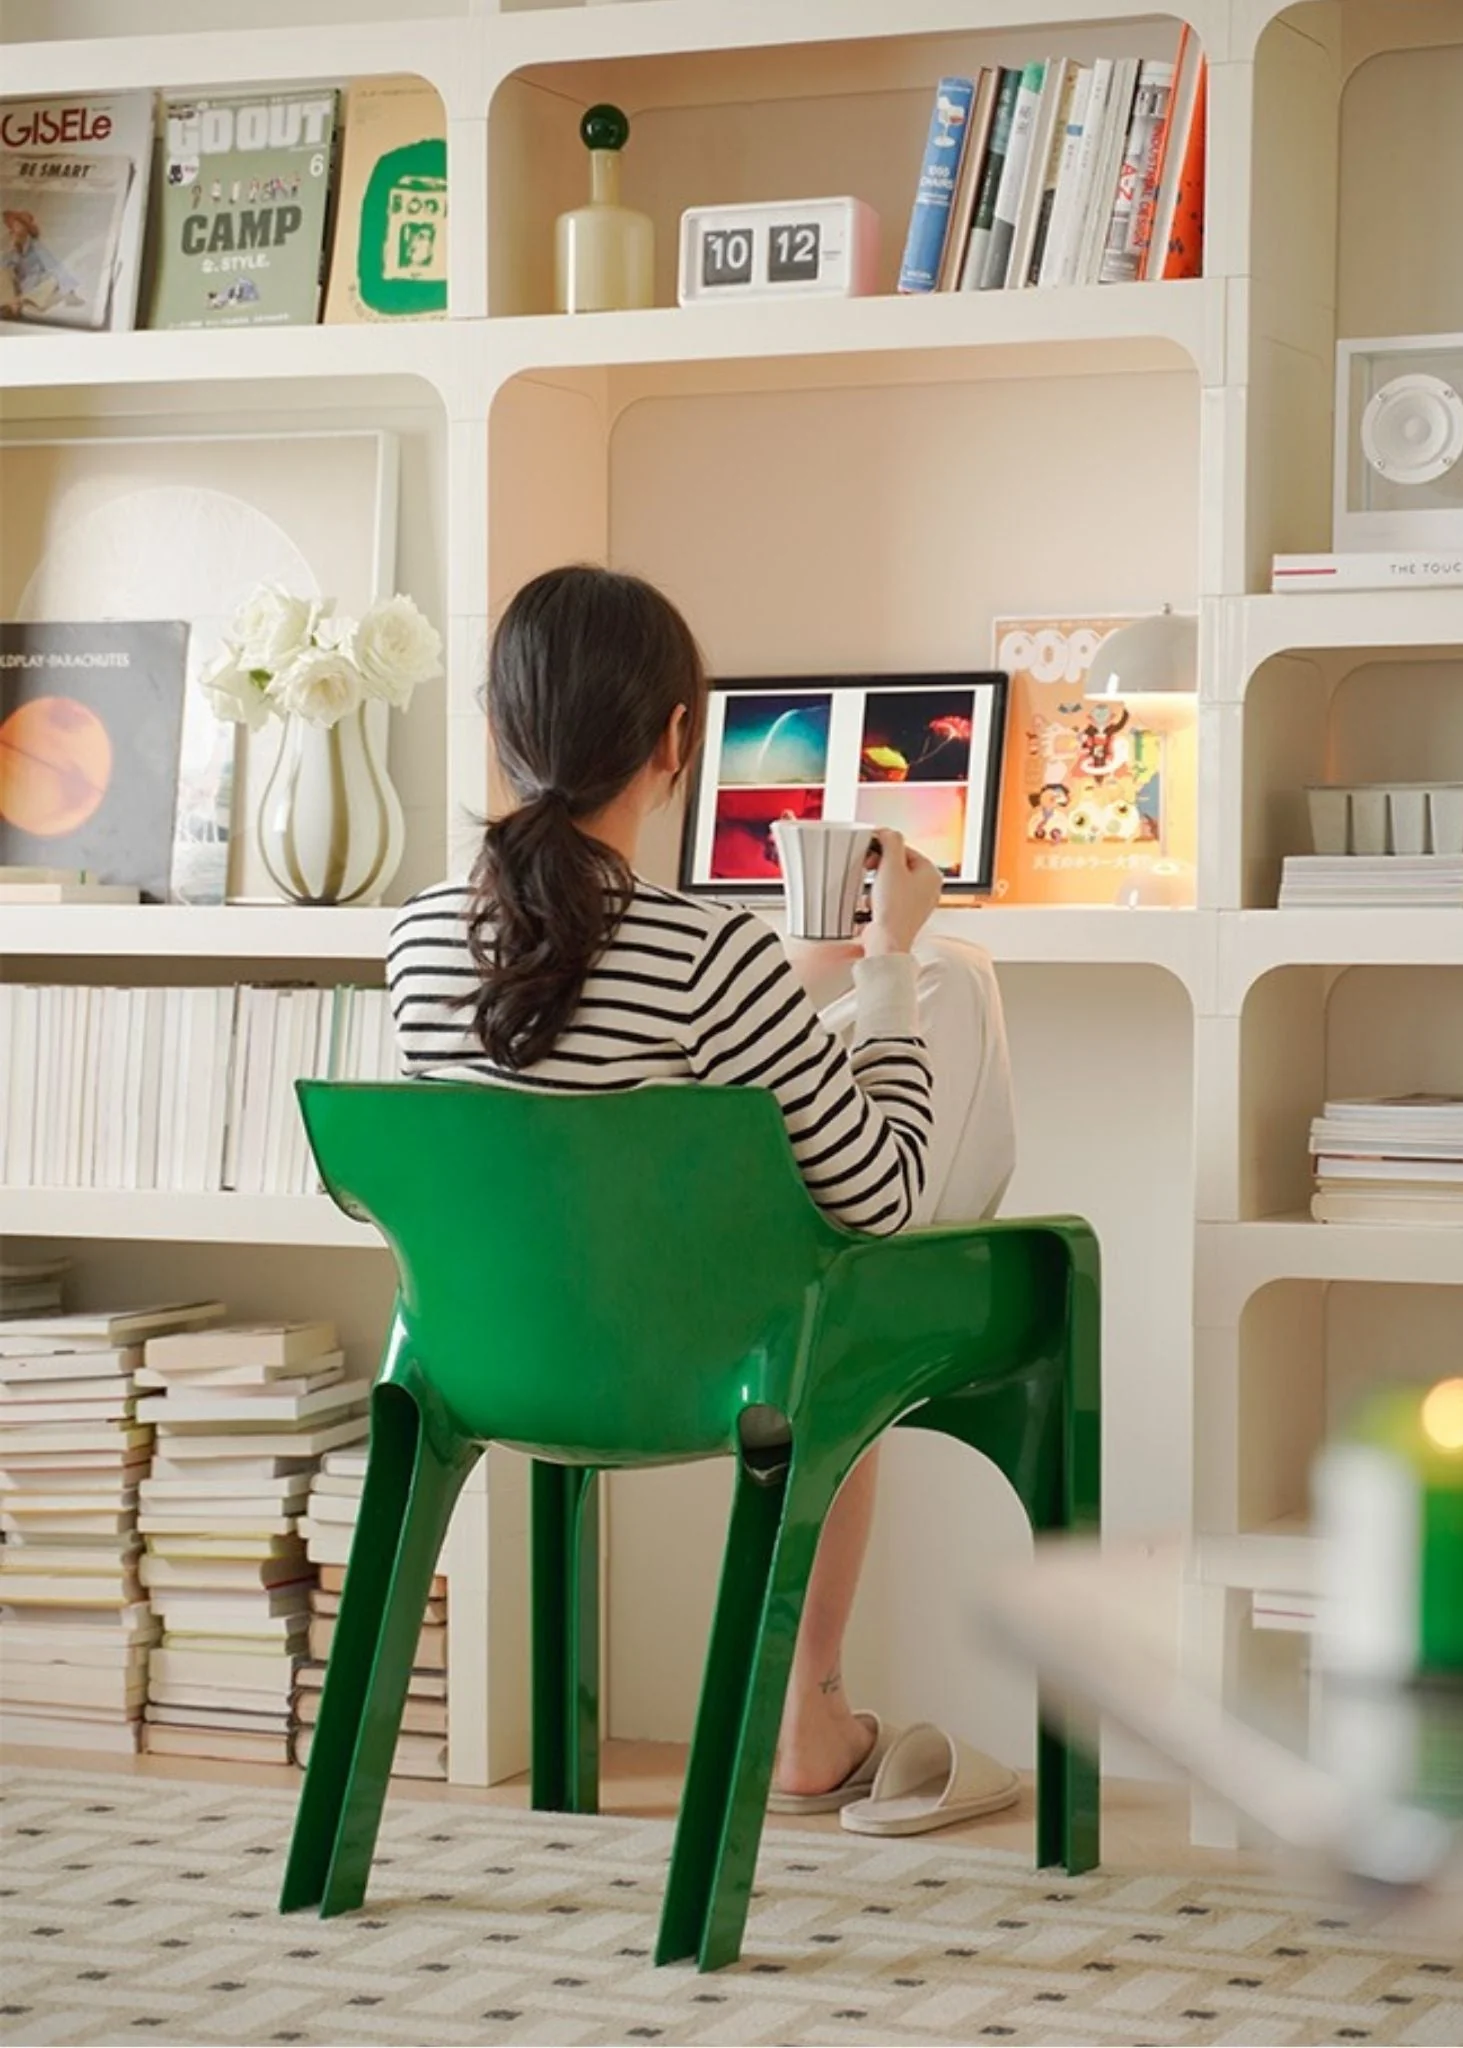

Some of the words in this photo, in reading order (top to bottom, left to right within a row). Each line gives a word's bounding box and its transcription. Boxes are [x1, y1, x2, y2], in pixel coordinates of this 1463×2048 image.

[166, 107, 234, 157] GO
[236, 100, 332, 151] OUT
[309, 153, 325, 177] 6
[181, 205, 303, 256] CAMP
[777, 229, 816, 263] 12
[711, 235, 750, 270] 10
[1389, 563, 1416, 575] THE
[999, 628, 1124, 683] POP
[996, 878, 1010, 898] 9
